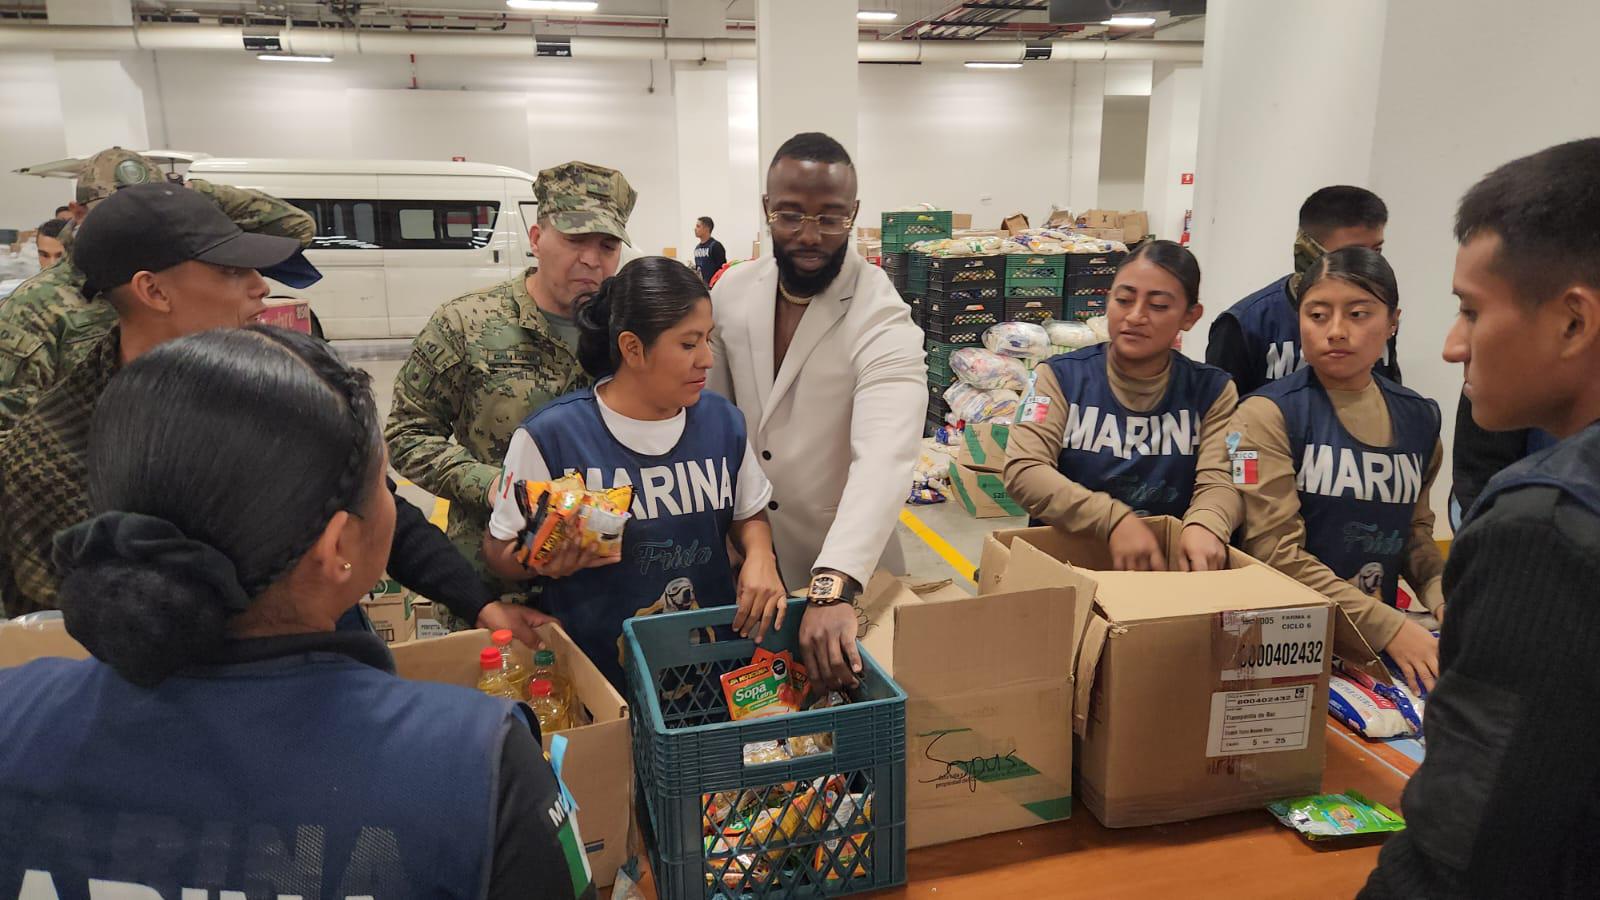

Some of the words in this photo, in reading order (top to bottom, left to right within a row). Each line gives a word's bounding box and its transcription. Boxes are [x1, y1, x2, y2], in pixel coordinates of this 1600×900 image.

[1297, 444, 1423, 504] MARIN
[633, 538, 713, 576] Frida
[735, 683, 767, 702] Sopa
